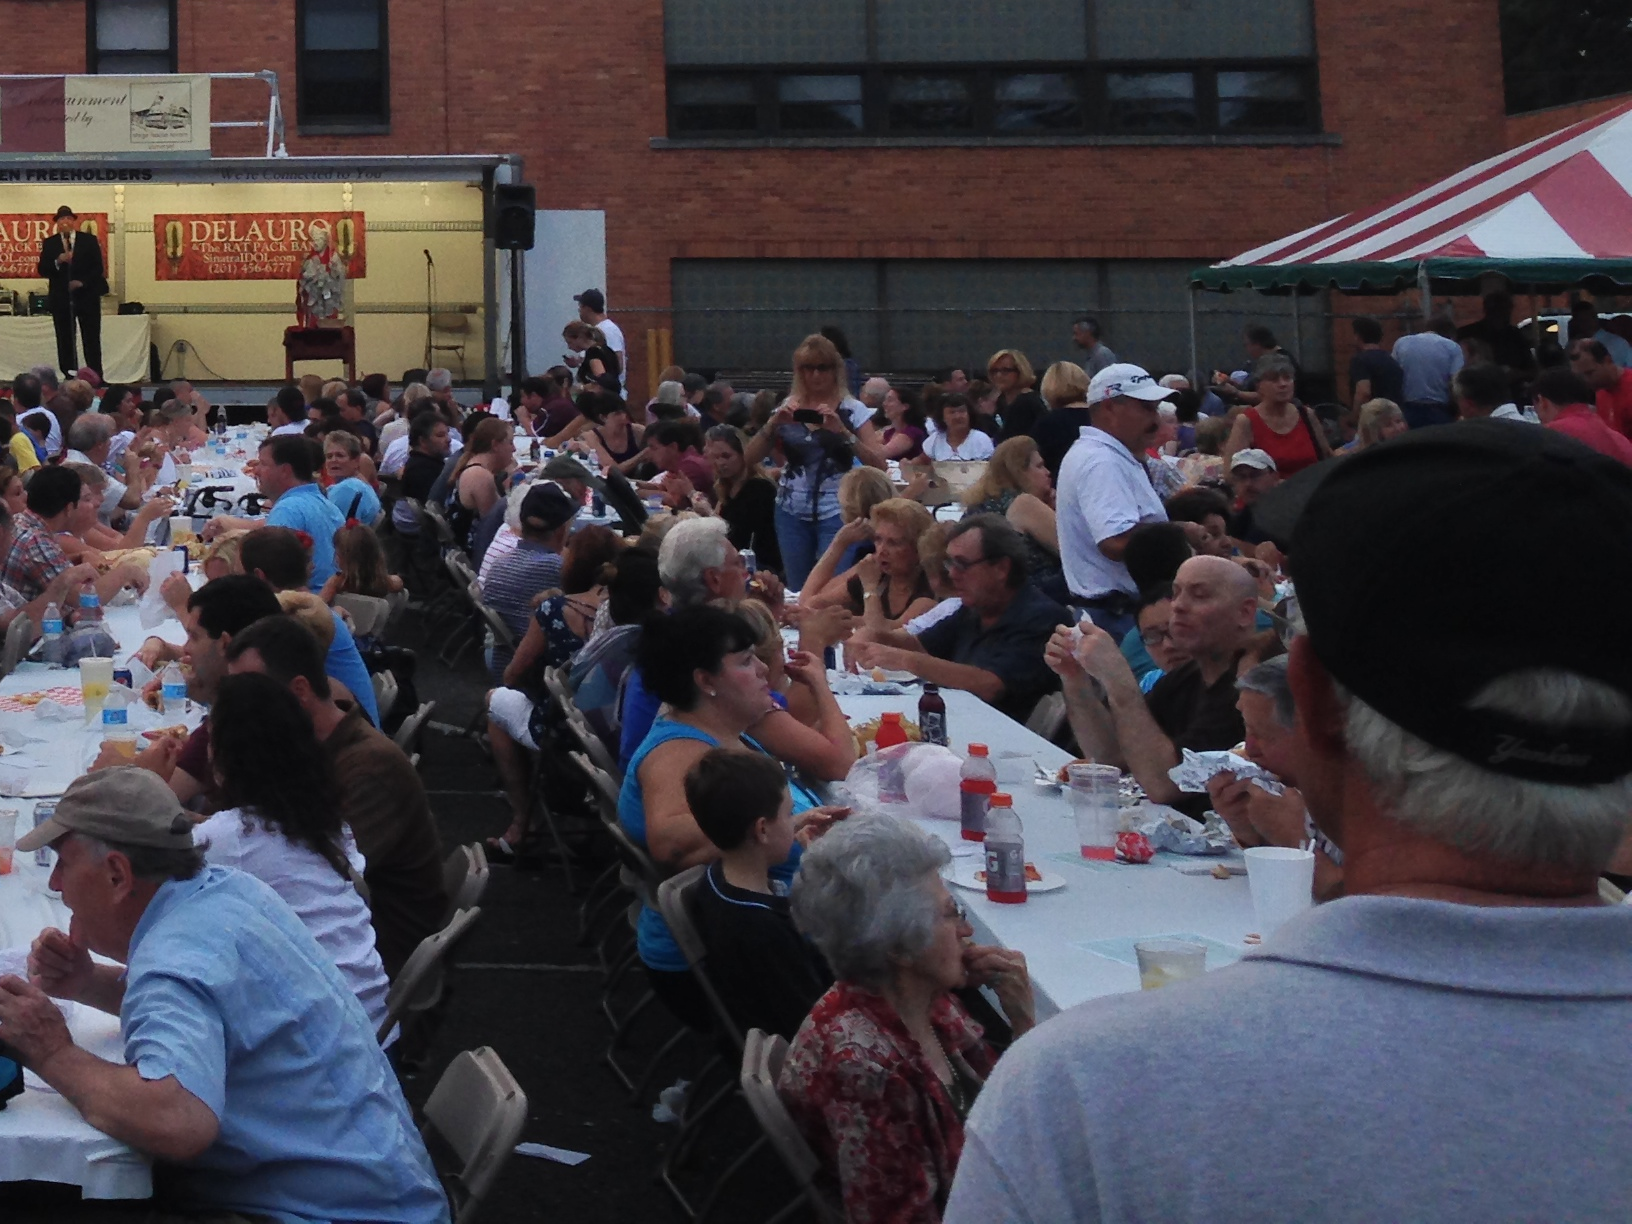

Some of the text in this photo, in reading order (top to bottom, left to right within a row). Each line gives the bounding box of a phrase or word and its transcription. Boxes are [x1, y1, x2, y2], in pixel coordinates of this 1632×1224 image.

[26, 168, 153, 181] FREEHOLDERS
[189, 218, 332, 243] DELAURO
[223, 242, 250, 253] RAT
[253, 241, 288, 252] PACK
[986, 850, 999, 873] G
